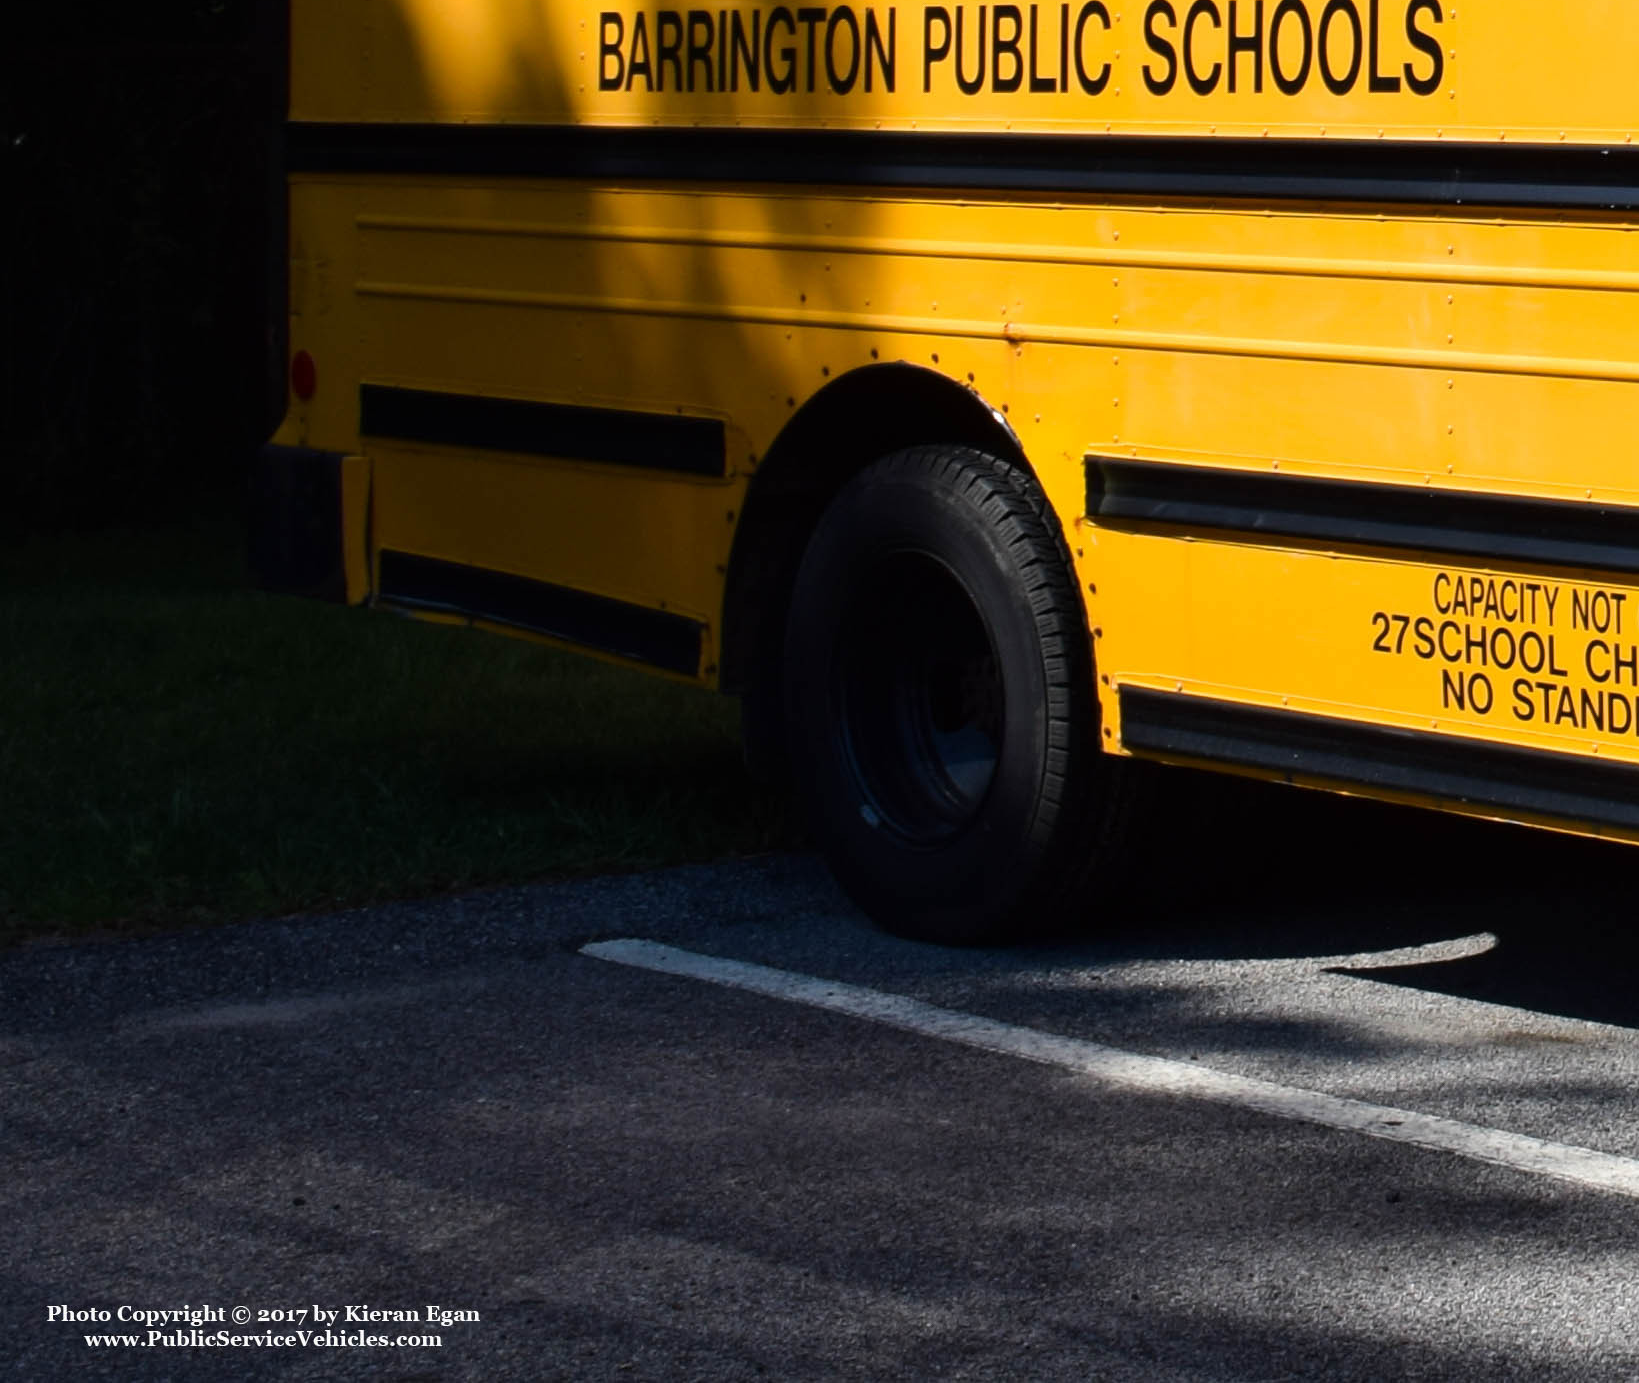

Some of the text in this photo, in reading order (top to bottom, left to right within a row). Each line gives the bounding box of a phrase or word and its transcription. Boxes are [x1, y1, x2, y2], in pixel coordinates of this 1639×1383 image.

[598, 4, 896, 95] BARRINGTON
[922, 0, 1112, 96] PUBLIC
[1433, 572, 1559, 627] CAPACITY
[1572, 589, 1627, 635] NOT
[1442, 669, 1493, 715] NO
